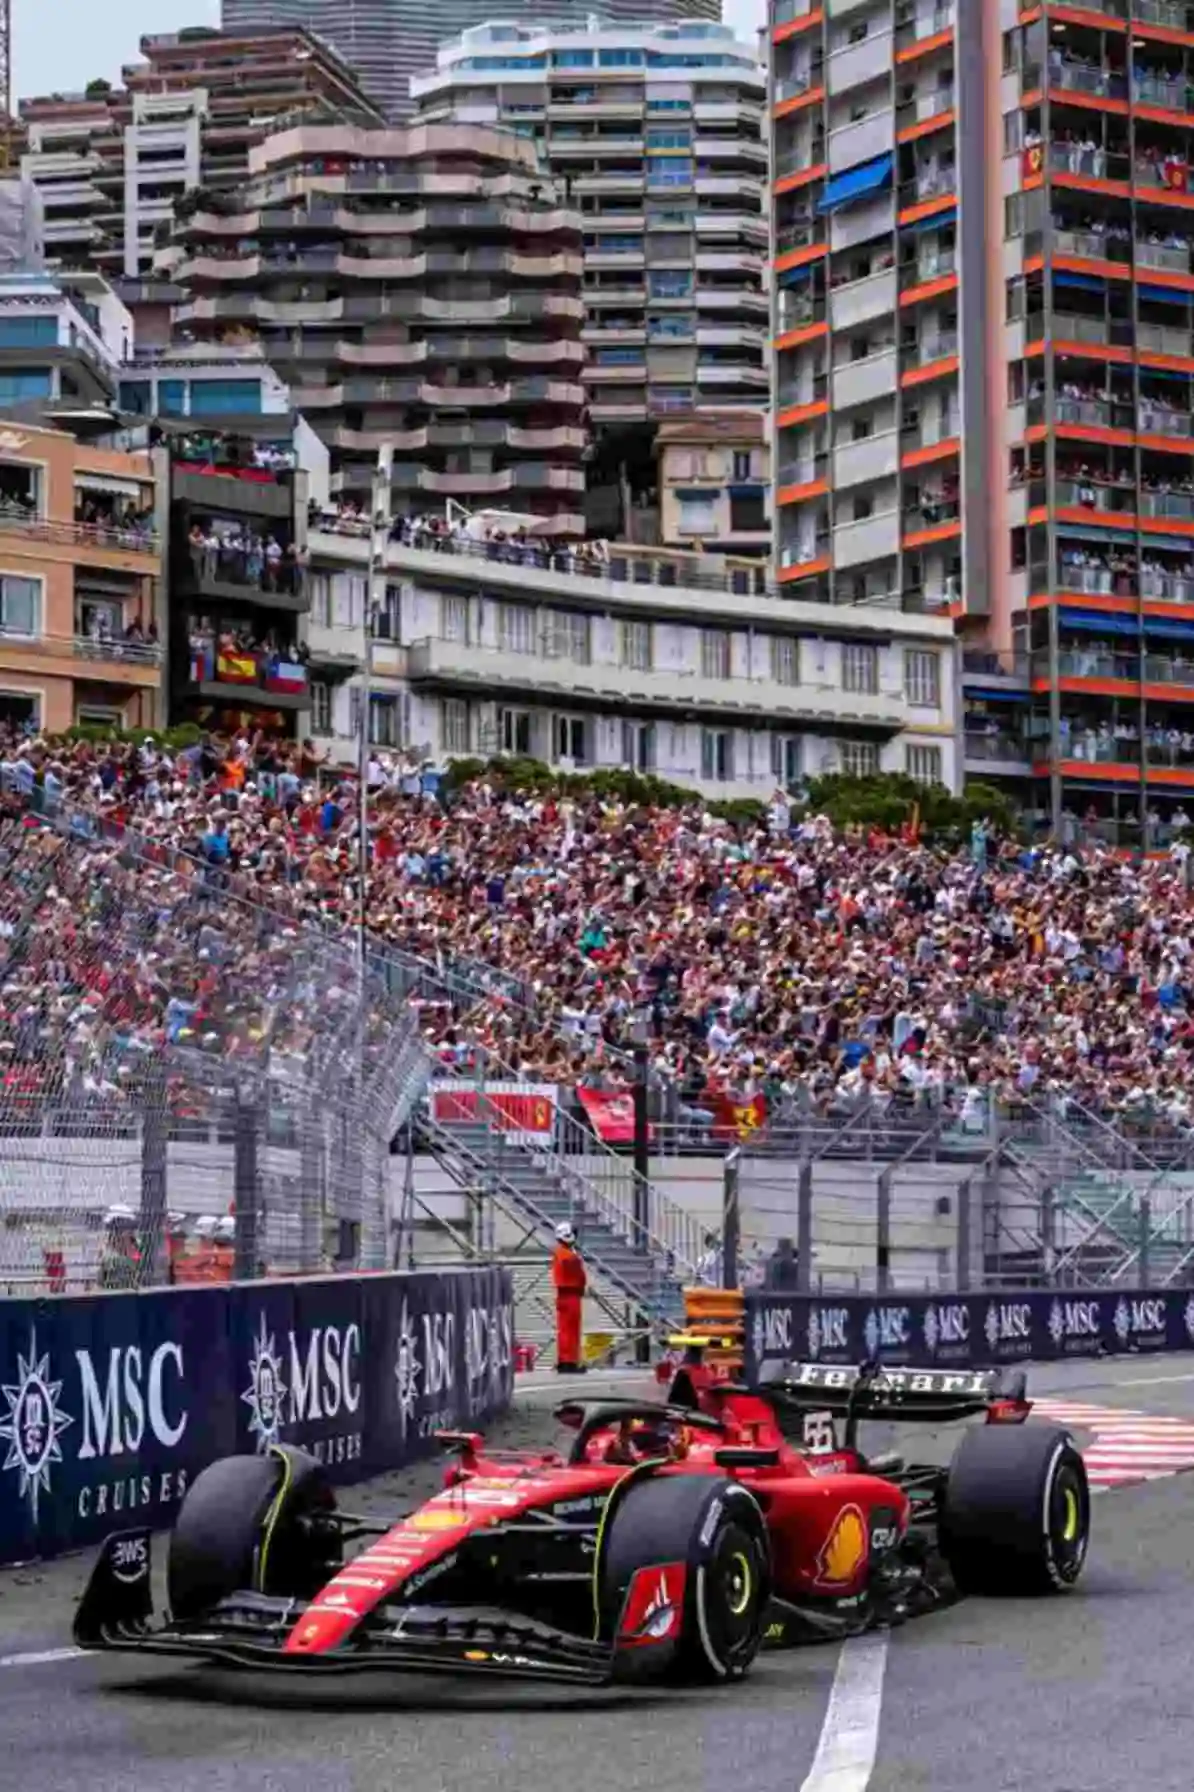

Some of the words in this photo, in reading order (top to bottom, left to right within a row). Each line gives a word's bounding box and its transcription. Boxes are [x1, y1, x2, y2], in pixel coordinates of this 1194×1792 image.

[765, 1308, 792, 1349] MSC
[938, 1305, 969, 1340] MSC
[1000, 1304, 1031, 1338] MSC
[1065, 1302, 1099, 1334] MSC
[1130, 1300, 1166, 1331] MSC
[288, 1324, 361, 1423] MSC
[797, 1364, 988, 1393] Ferari
[76, 1342, 187, 1459] MSC
[301, 1433, 361, 1464] UISES
[804, 1411, 833, 1454] 55
[78, 1469, 188, 1517] CRUISES
